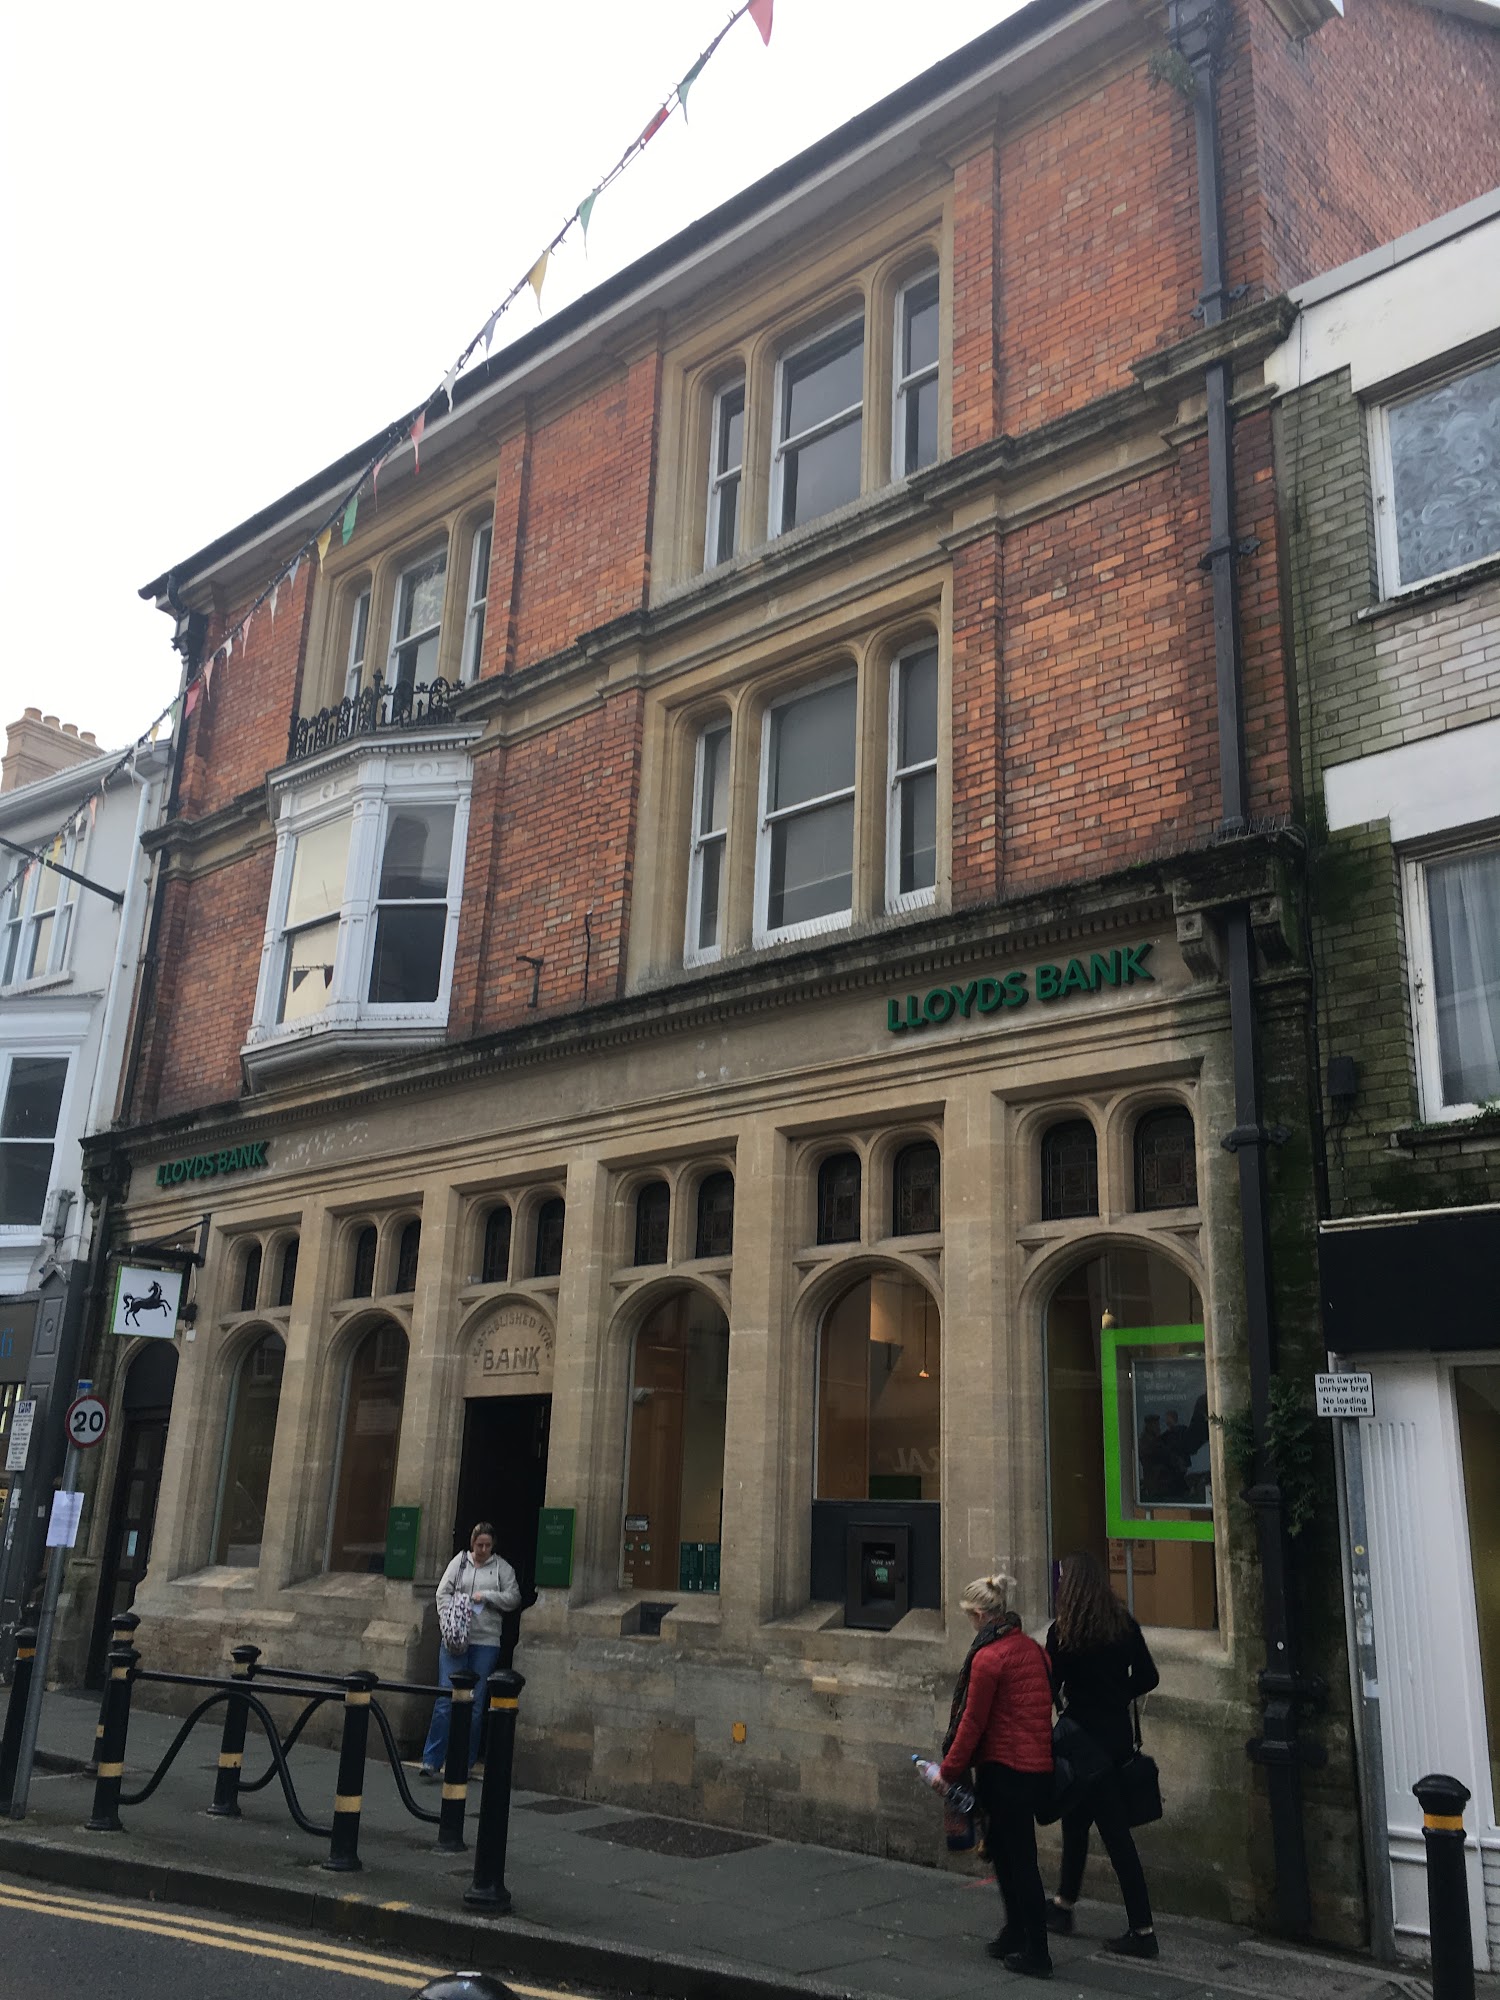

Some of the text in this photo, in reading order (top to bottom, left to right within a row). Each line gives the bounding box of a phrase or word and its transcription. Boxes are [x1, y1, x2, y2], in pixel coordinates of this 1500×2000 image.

[887, 943, 1154, 1032] LLOYDS BANK
[155, 1140, 269, 1187] LLOYDS BANK
[473, 1312, 537, 1357] ESTABLISHED
[483, 1346, 541, 1371] BANK
[1318, 1385, 1369, 1394] unrhyw bryd
[1319, 1376, 1335, 1384] Dim
[1322, 1396, 1367, 1405] No loading
[73, 1410, 104, 1432] 20
